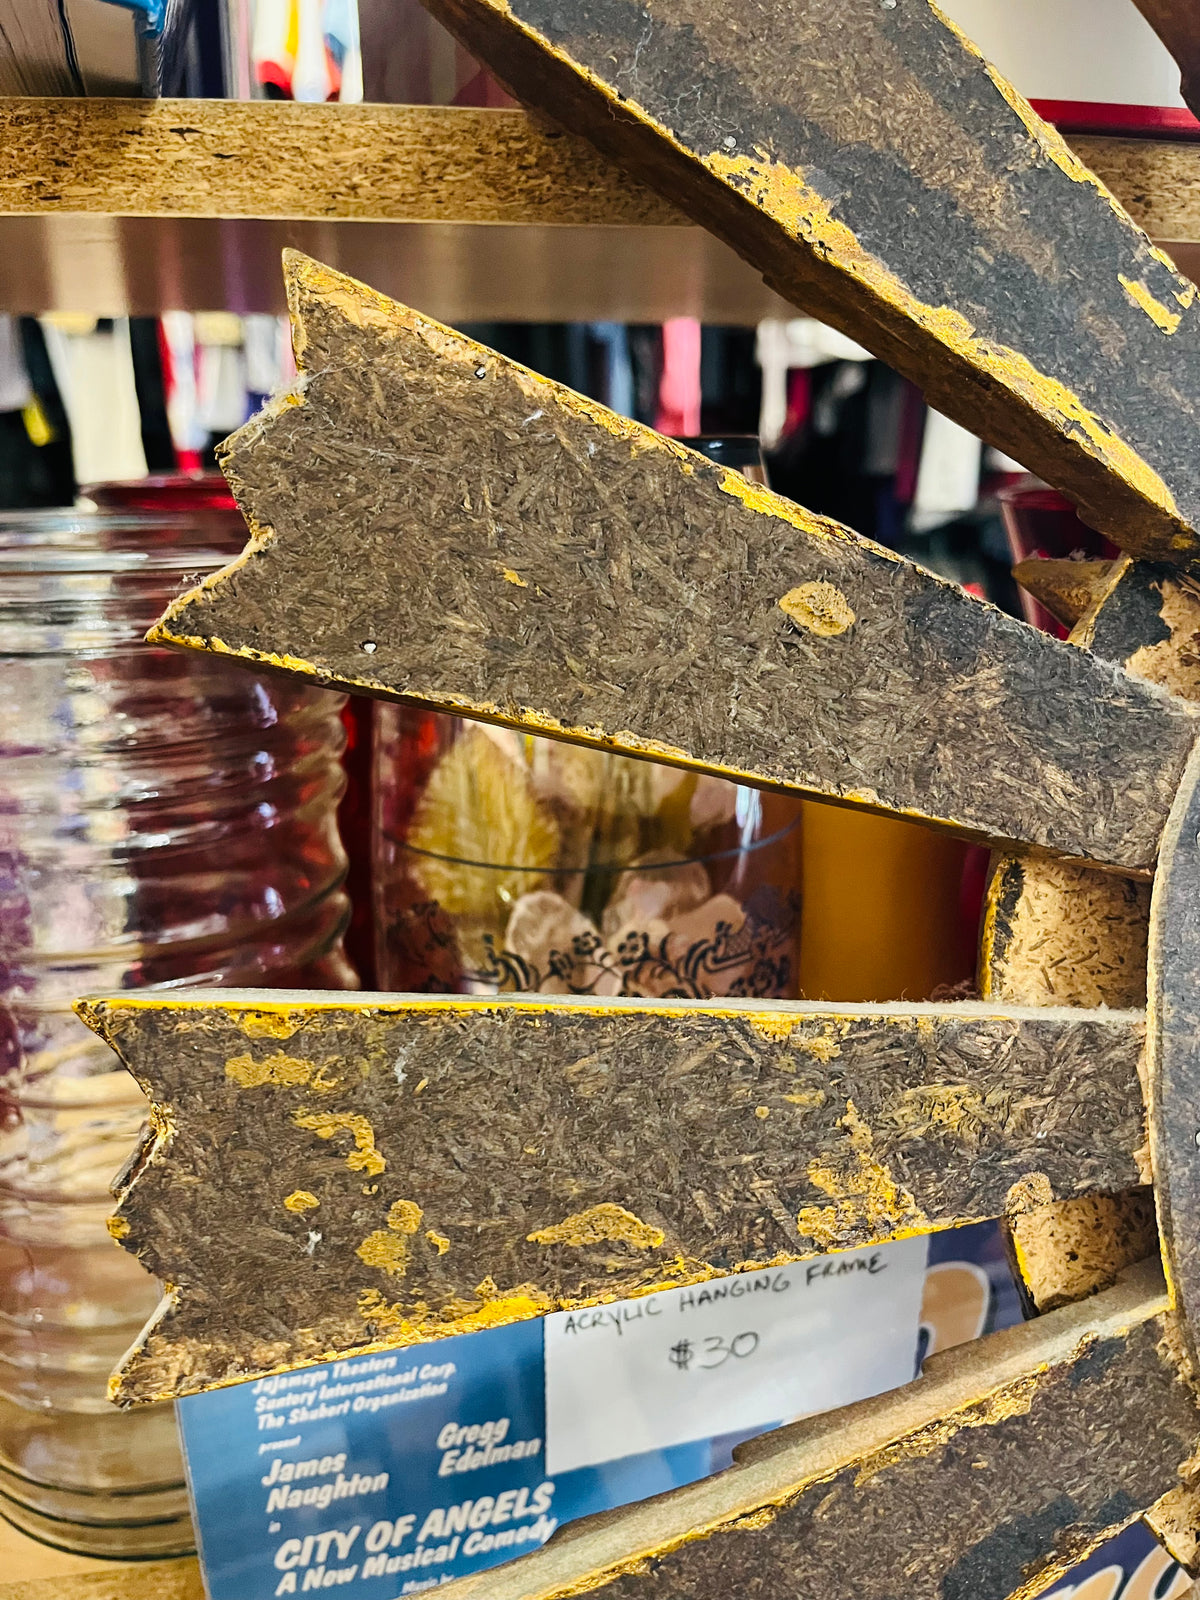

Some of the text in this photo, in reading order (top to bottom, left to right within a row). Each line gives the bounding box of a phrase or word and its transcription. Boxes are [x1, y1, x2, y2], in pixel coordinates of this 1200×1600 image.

[564, 1251, 888, 1335] ACRYLIC HANGING FRAME
[333, 1356, 397, 1377] Theaters
[669, 1332, 759, 1370] $30
[255, 1389, 316, 1413] Suntory
[319, 1370, 417, 1402] International
[258, 1383, 447, 1430] The Shubert Organization
[437, 1418, 510, 1450] Gregg
[261, 1453, 347, 1486] James
[438, 1438, 541, 1476] Edelman
[266, 1472, 389, 1513] Naughton
[275, 1482, 555, 1570] CITY OF ANGELS
[275, 1515, 558, 1596] A New Musical Comedy
